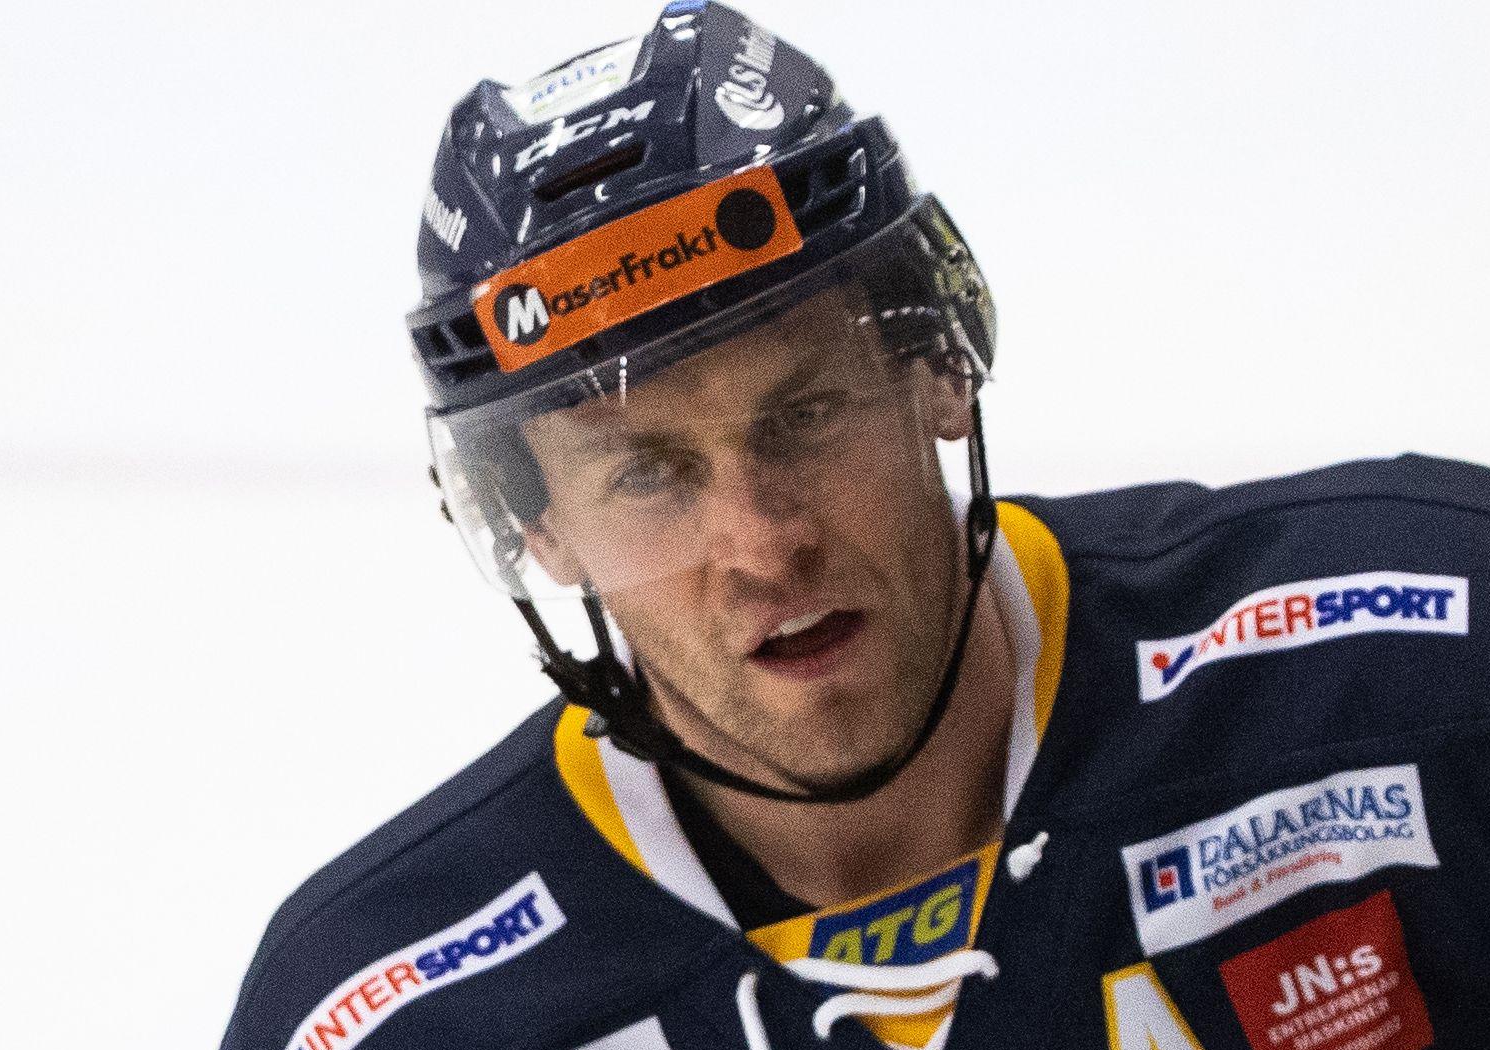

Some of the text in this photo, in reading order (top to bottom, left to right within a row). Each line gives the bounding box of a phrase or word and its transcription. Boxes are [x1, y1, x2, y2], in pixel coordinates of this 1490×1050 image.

[506, 225, 721, 343] MaserFrakt
[1199, 783, 1412, 869] DALARNAS
[820, 884, 964, 965] ATG
[1270, 944, 1383, 1016] JN:s
